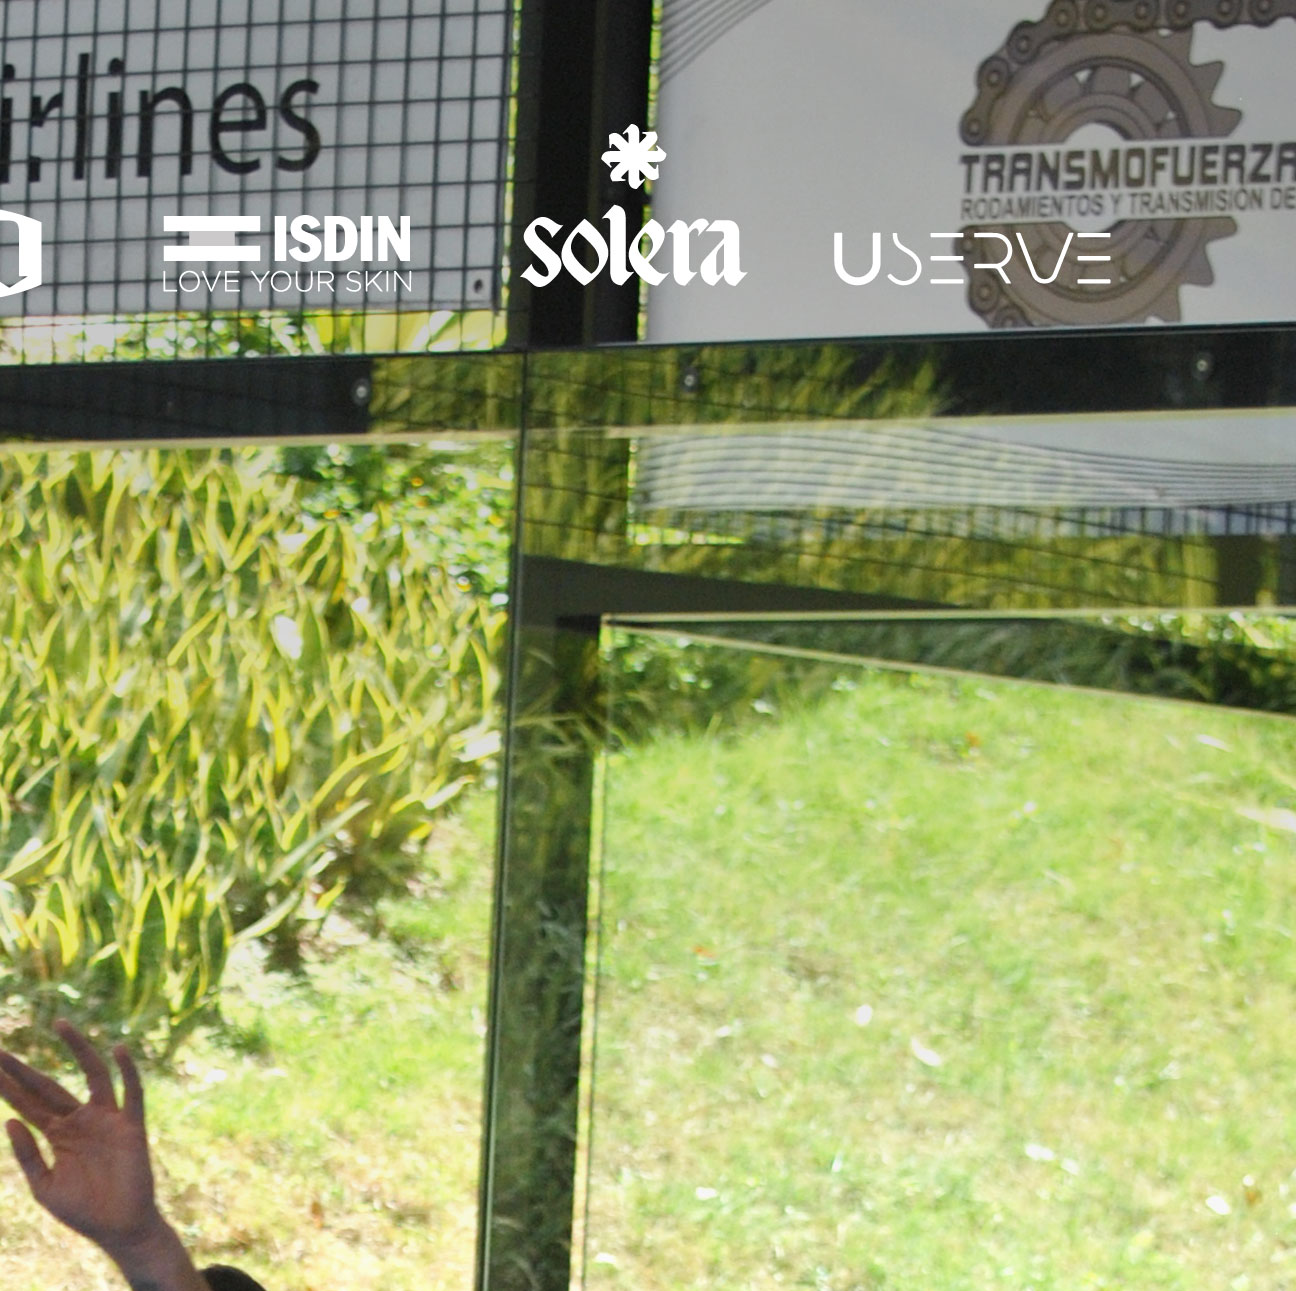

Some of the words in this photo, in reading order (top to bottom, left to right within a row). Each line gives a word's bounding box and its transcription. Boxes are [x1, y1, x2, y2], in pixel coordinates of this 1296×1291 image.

[960, 141, 1296, 194] TRANSMOFUERZA
[960, 194, 1104, 221] RODAMIENTOS
[1109, 192, 1124, 215] Y
